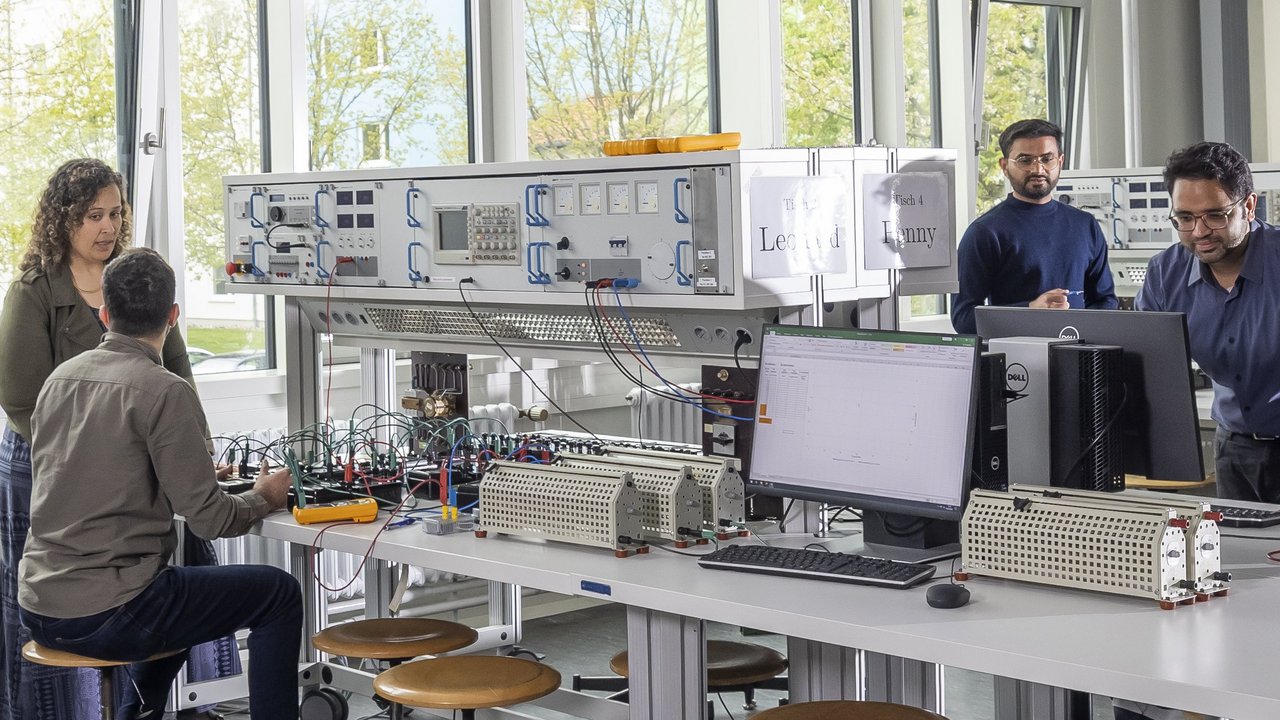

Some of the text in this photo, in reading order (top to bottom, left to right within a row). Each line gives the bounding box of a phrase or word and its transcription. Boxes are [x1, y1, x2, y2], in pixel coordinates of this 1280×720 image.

[783, 198, 809, 211] Tih
[918, 194, 924, 206] 4
[759, 224, 840, 252] Leod
[1008, 373, 1026, 381] DELL
